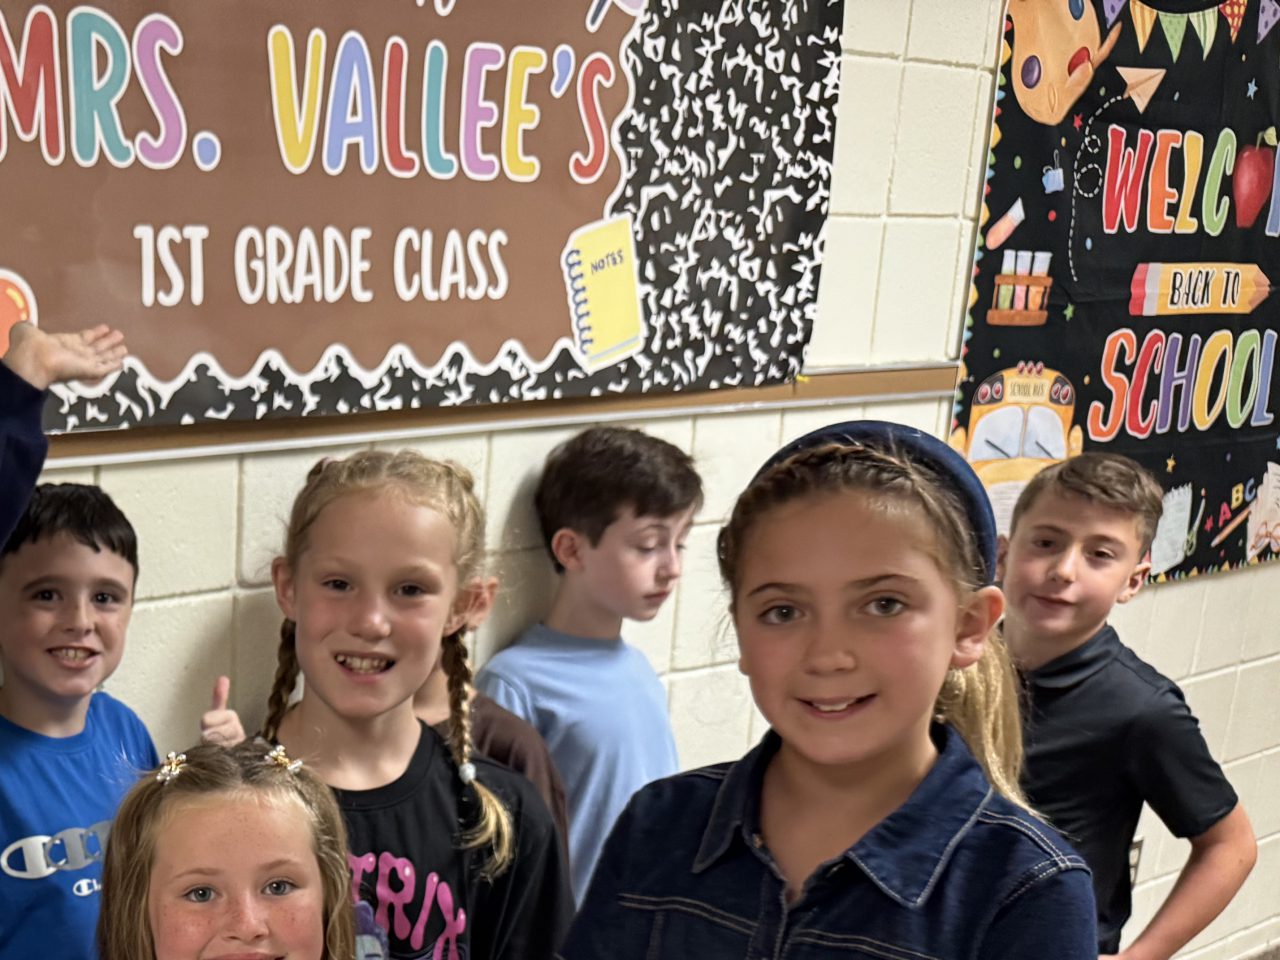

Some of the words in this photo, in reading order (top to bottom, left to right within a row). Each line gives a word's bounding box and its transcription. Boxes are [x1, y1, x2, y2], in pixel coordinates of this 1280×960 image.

[267, 25, 614, 184] VALLEE'S
[133, 225, 209, 308] 1ST
[234, 226, 373, 304] GRADE
[394, 229, 508, 301] CLASS
[1169, 268, 1215, 308] BACK
[1221, 269, 1241, 309] TO
[1087, 328, 1278, 442] SCHOOL
